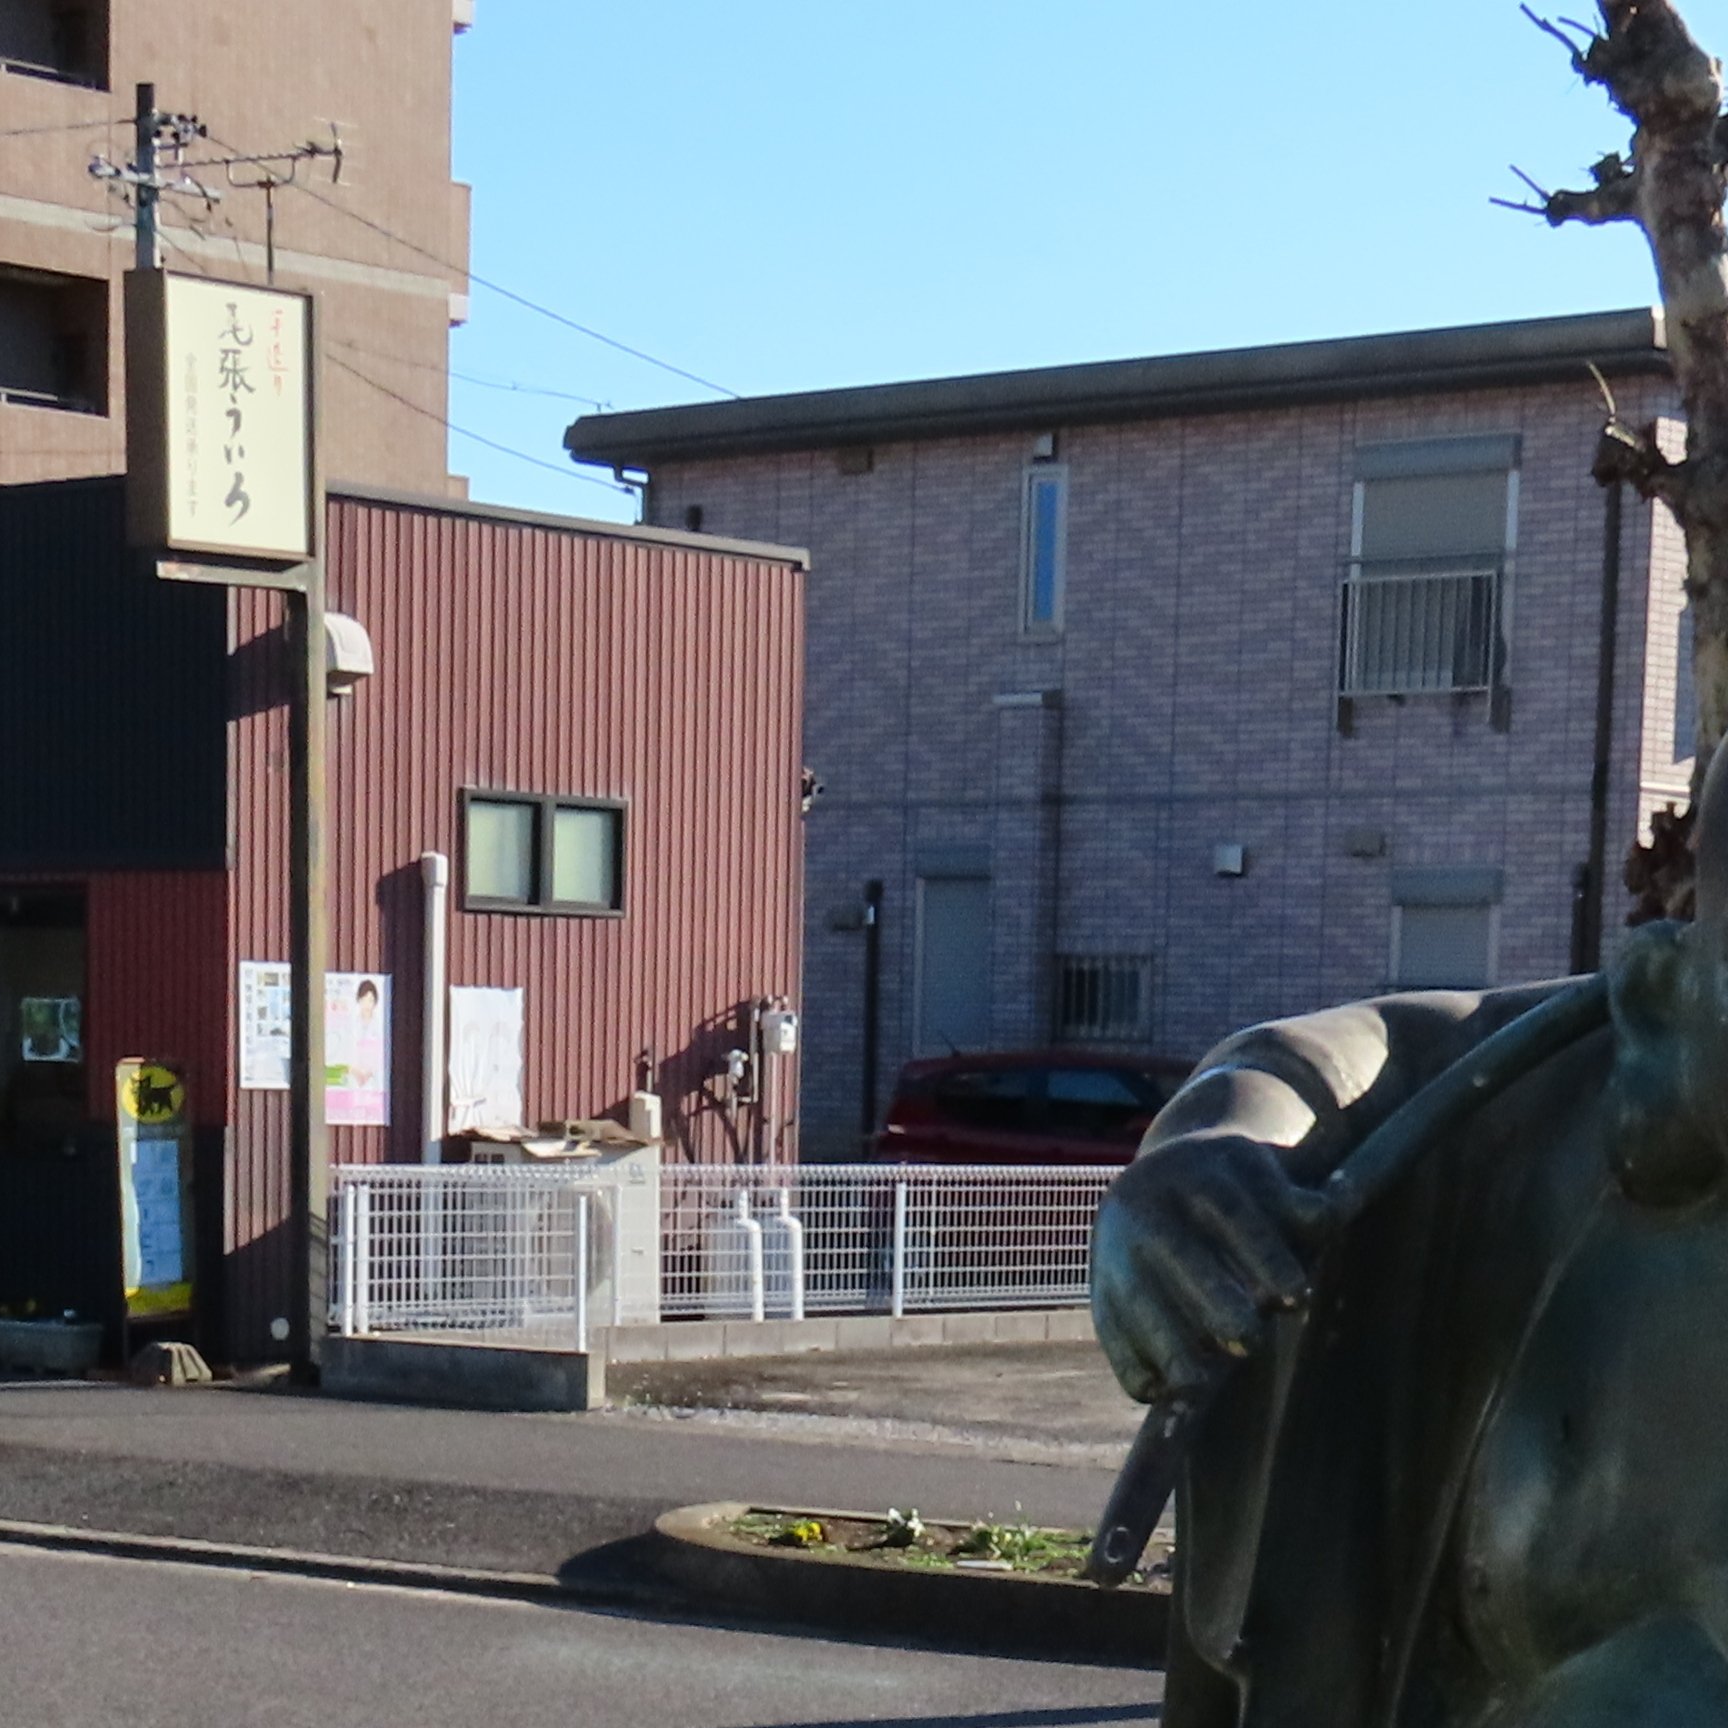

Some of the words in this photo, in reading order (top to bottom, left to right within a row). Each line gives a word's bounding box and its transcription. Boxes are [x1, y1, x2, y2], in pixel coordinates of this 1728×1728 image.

[217, 303, 255, 528] 尾張ういろ
